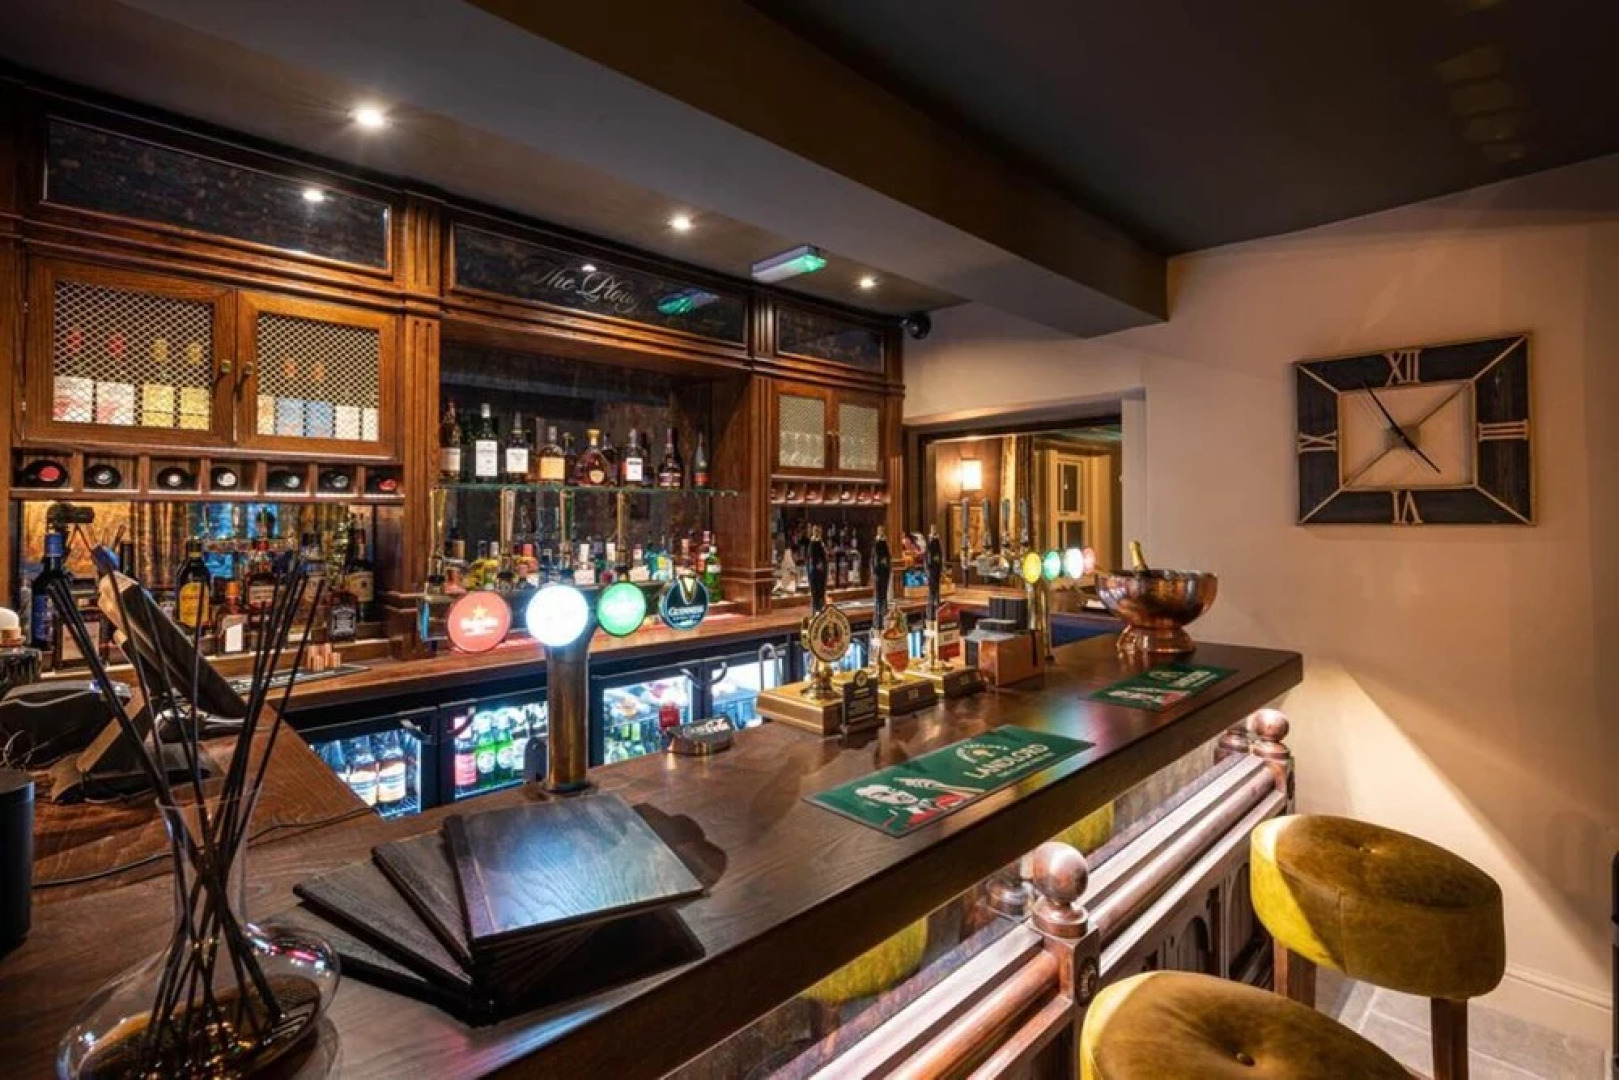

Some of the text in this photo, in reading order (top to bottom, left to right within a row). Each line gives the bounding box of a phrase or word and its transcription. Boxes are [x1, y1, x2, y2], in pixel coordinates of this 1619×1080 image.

[532, 266, 577, 292] The
[1385, 349, 1422, 387] XII
[963, 743, 1050, 780] LANDLORD
